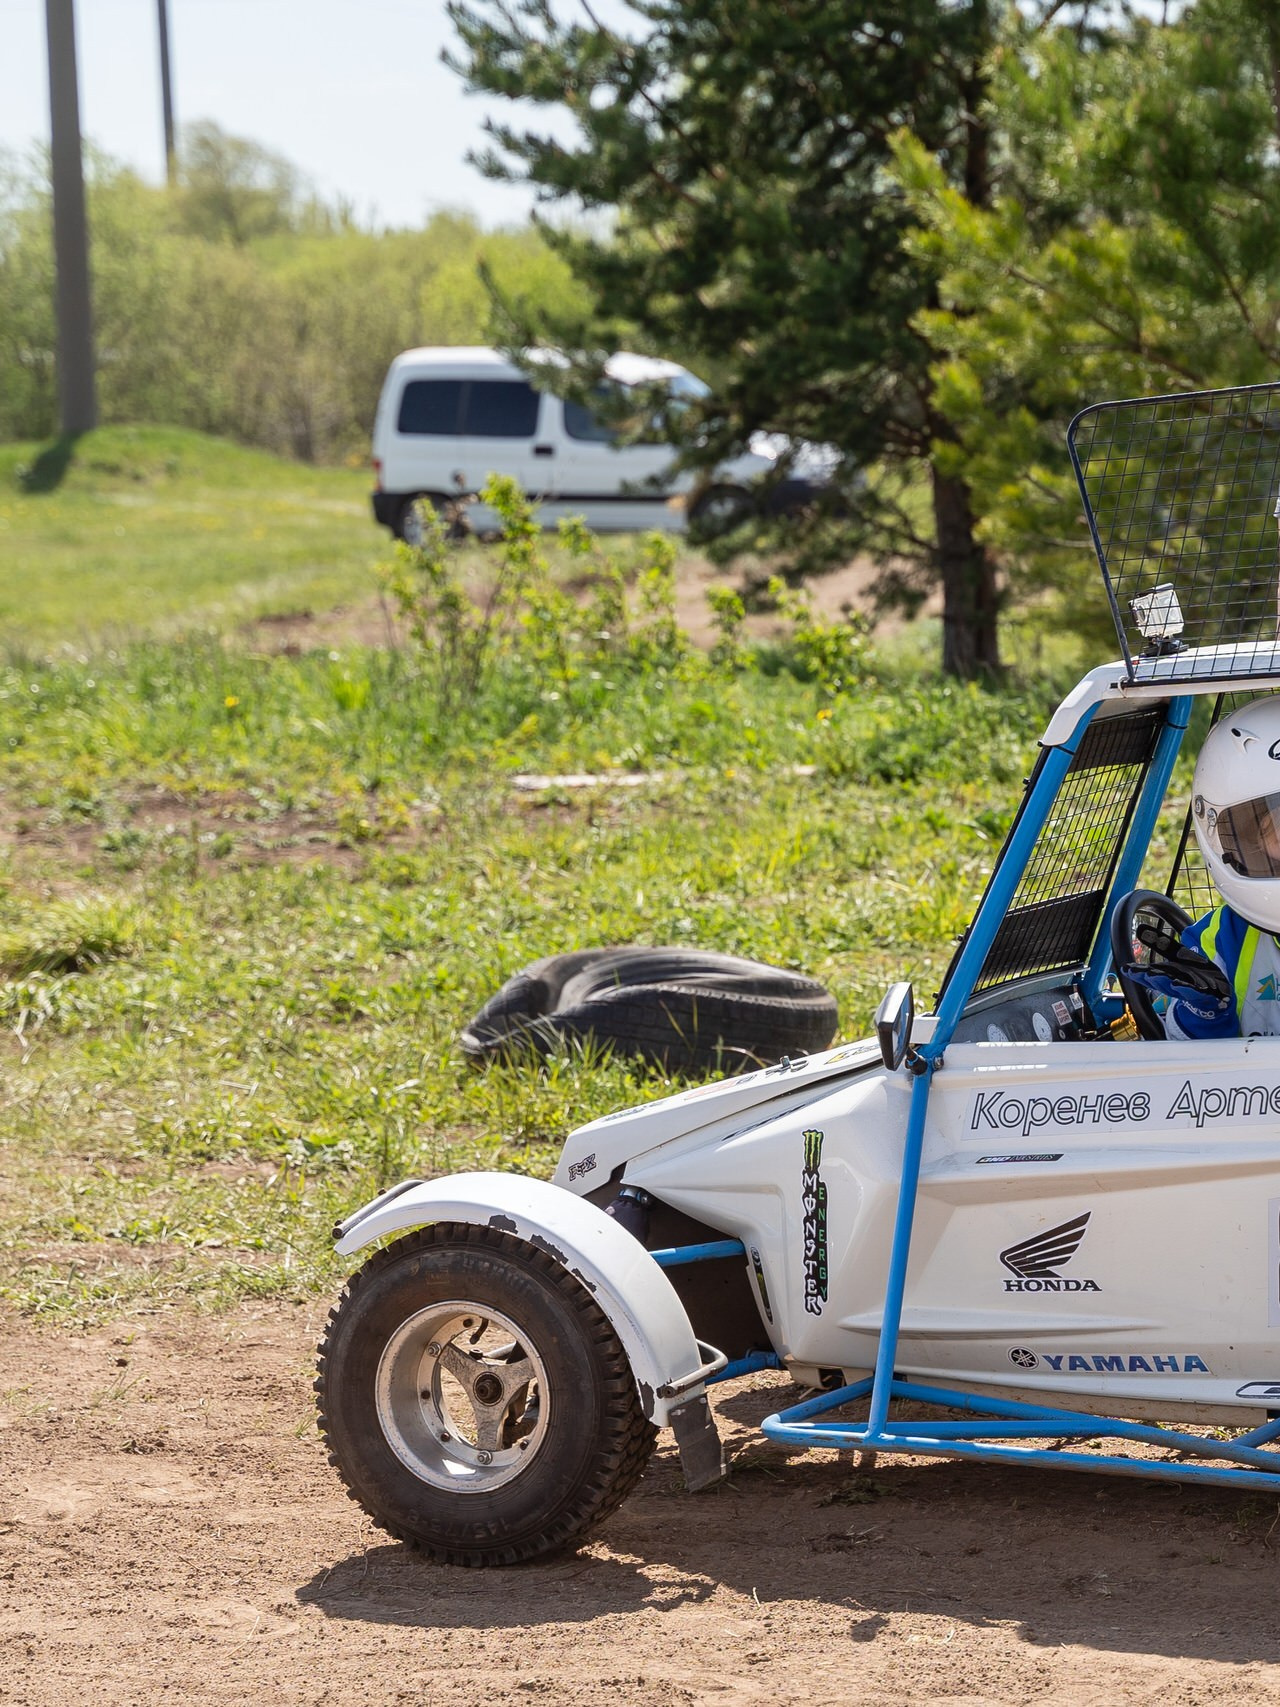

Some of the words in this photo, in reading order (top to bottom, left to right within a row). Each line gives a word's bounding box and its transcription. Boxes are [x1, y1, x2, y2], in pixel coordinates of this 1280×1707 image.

[971, 1091, 1151, 1137] Коренев
[817, 1186, 828, 1299] ENERGY
[1003, 1279, 1103, 1292] HONDA
[1041, 1355, 1210, 1373] YAMAHA
